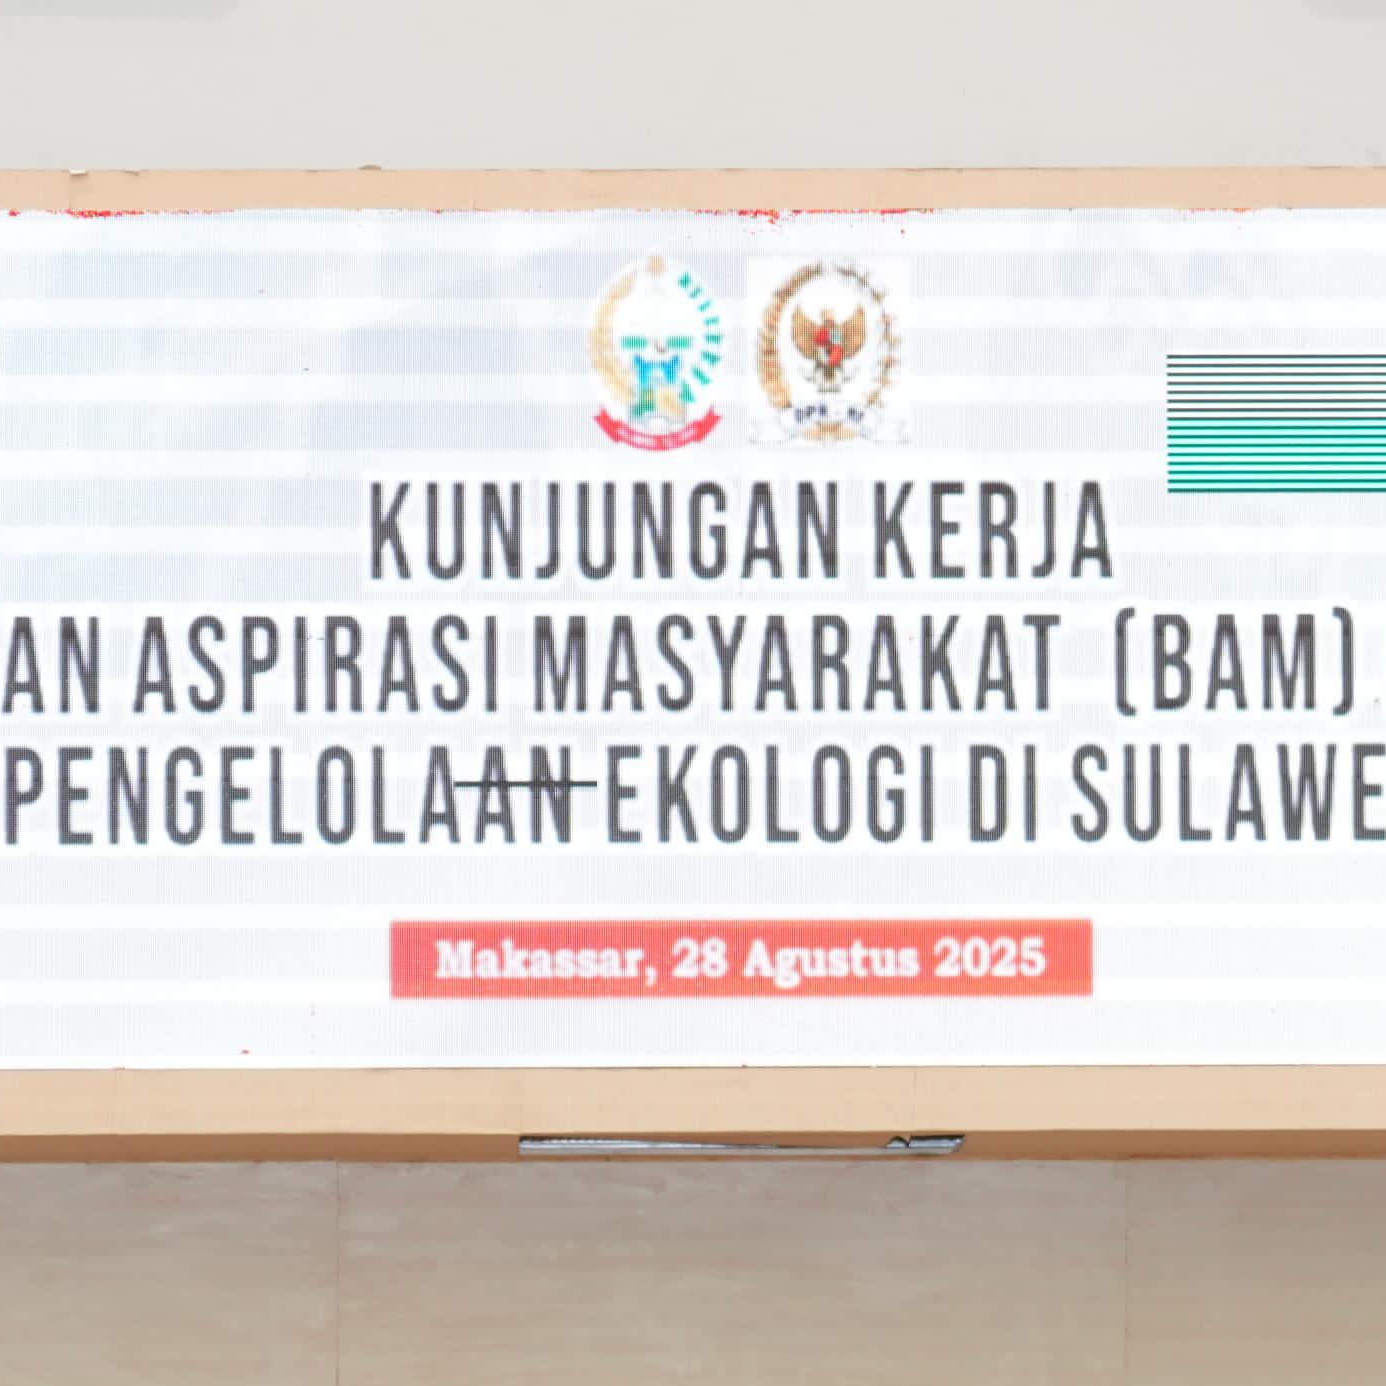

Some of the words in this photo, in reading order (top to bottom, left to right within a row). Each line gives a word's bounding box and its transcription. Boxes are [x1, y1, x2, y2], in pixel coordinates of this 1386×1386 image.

[370, 481, 839, 580] KUNJUNGAN
[874, 480, 1113, 579] KERJA
[133, 614, 497, 714] ASPIRASI
[534, 613, 1060, 712] MASYARAKAT
[1113, 607, 1356, 716] (BAM)
[4, 744, 572, 846] PENGELOLAAN
[607, 743, 934, 844] EKOLOGI
[969, 743, 1037, 842] DI
[435, 938, 657, 985] Makassar,
[672, 937, 728, 979] 28
[743, 937, 920, 987] Agustus
[933, 936, 1047, 978] 2025
